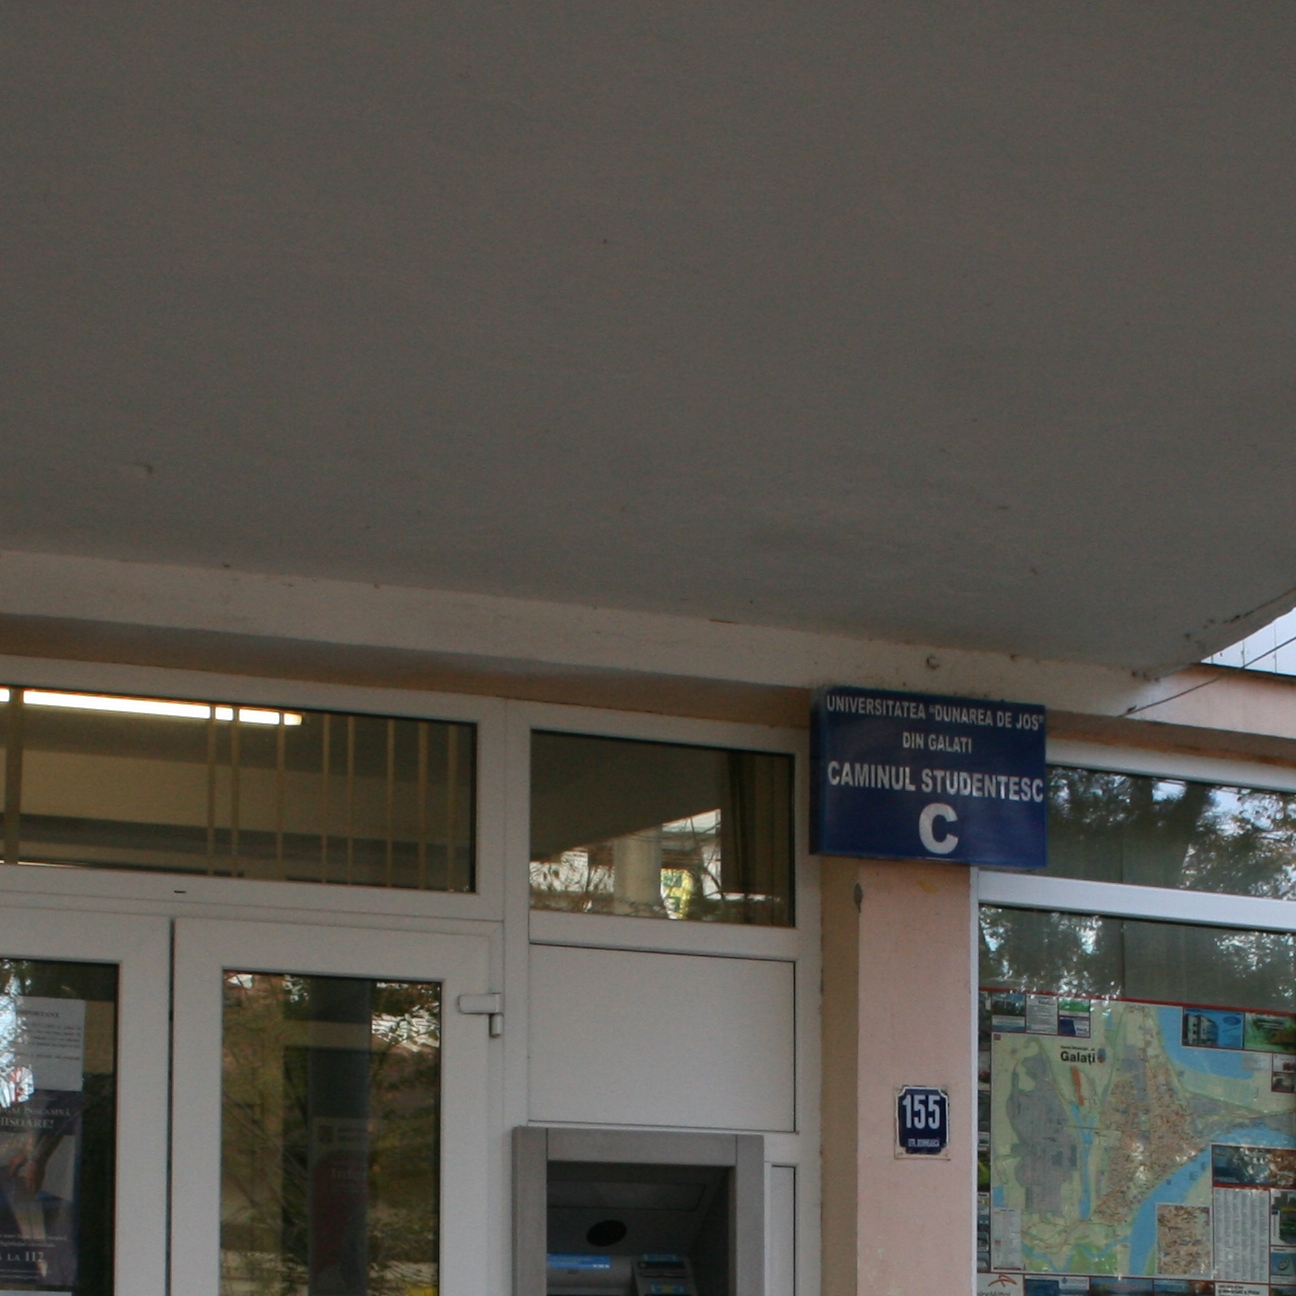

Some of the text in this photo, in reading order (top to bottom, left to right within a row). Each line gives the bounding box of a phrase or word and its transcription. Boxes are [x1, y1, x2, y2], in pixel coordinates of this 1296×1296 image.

[826, 694, 926, 720] UNIVERSITATEA
[996, 710, 1012, 728] DE
[902, 731, 972, 754] DIN GALATI
[827, 761, 1044, 803] CAMINUL STUDENTESC
[918, 802, 959, 855] C
[902, 1094, 941, 1130] 155
[24, 1250, 45, 1262] 112
